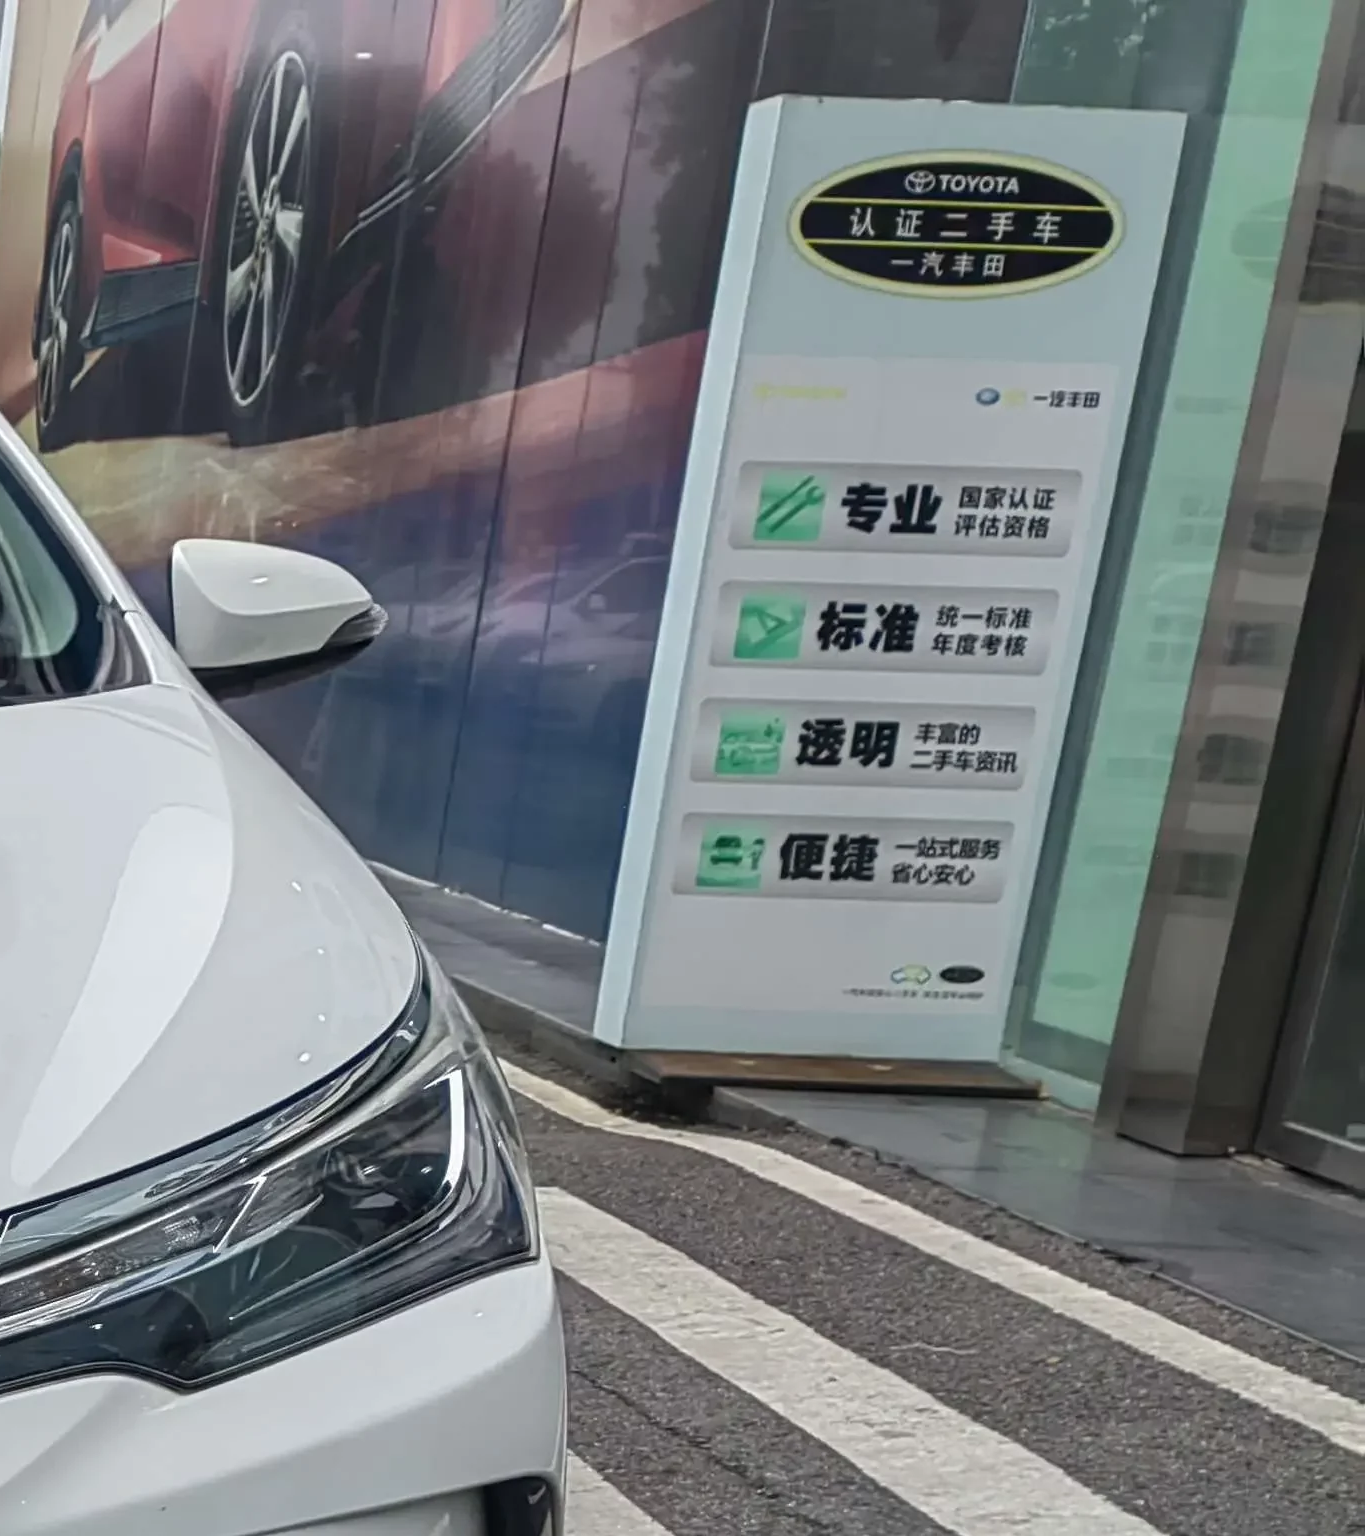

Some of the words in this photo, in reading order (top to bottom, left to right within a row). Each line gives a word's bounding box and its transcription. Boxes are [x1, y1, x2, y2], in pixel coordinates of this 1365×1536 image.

[939, 173, 1019, 195] TOYOTA
[849, 206, 1062, 244] 认证二手车
[890, 252, 1006, 278] 一汽丰田
[1033, 391, 1100, 409] 一汽丰田
[841, 482, 943, 535] 专业
[958, 485, 1057, 511] 国家认证
[953, 514, 1051, 540] 评估资格
[816, 601, 920, 654] 标准
[934, 605, 1033, 630] 统一标准
[931, 632, 1029, 658] 年度考核
[795, 718, 901, 768] 透明
[914, 722, 981, 745] 丰富的
[909, 750, 1018, 774] 二手车资讯
[779, 832, 879, 883] 便捷
[894, 837, 1003, 862] 一站式服务
[891, 863, 976, 887] 省心安心
